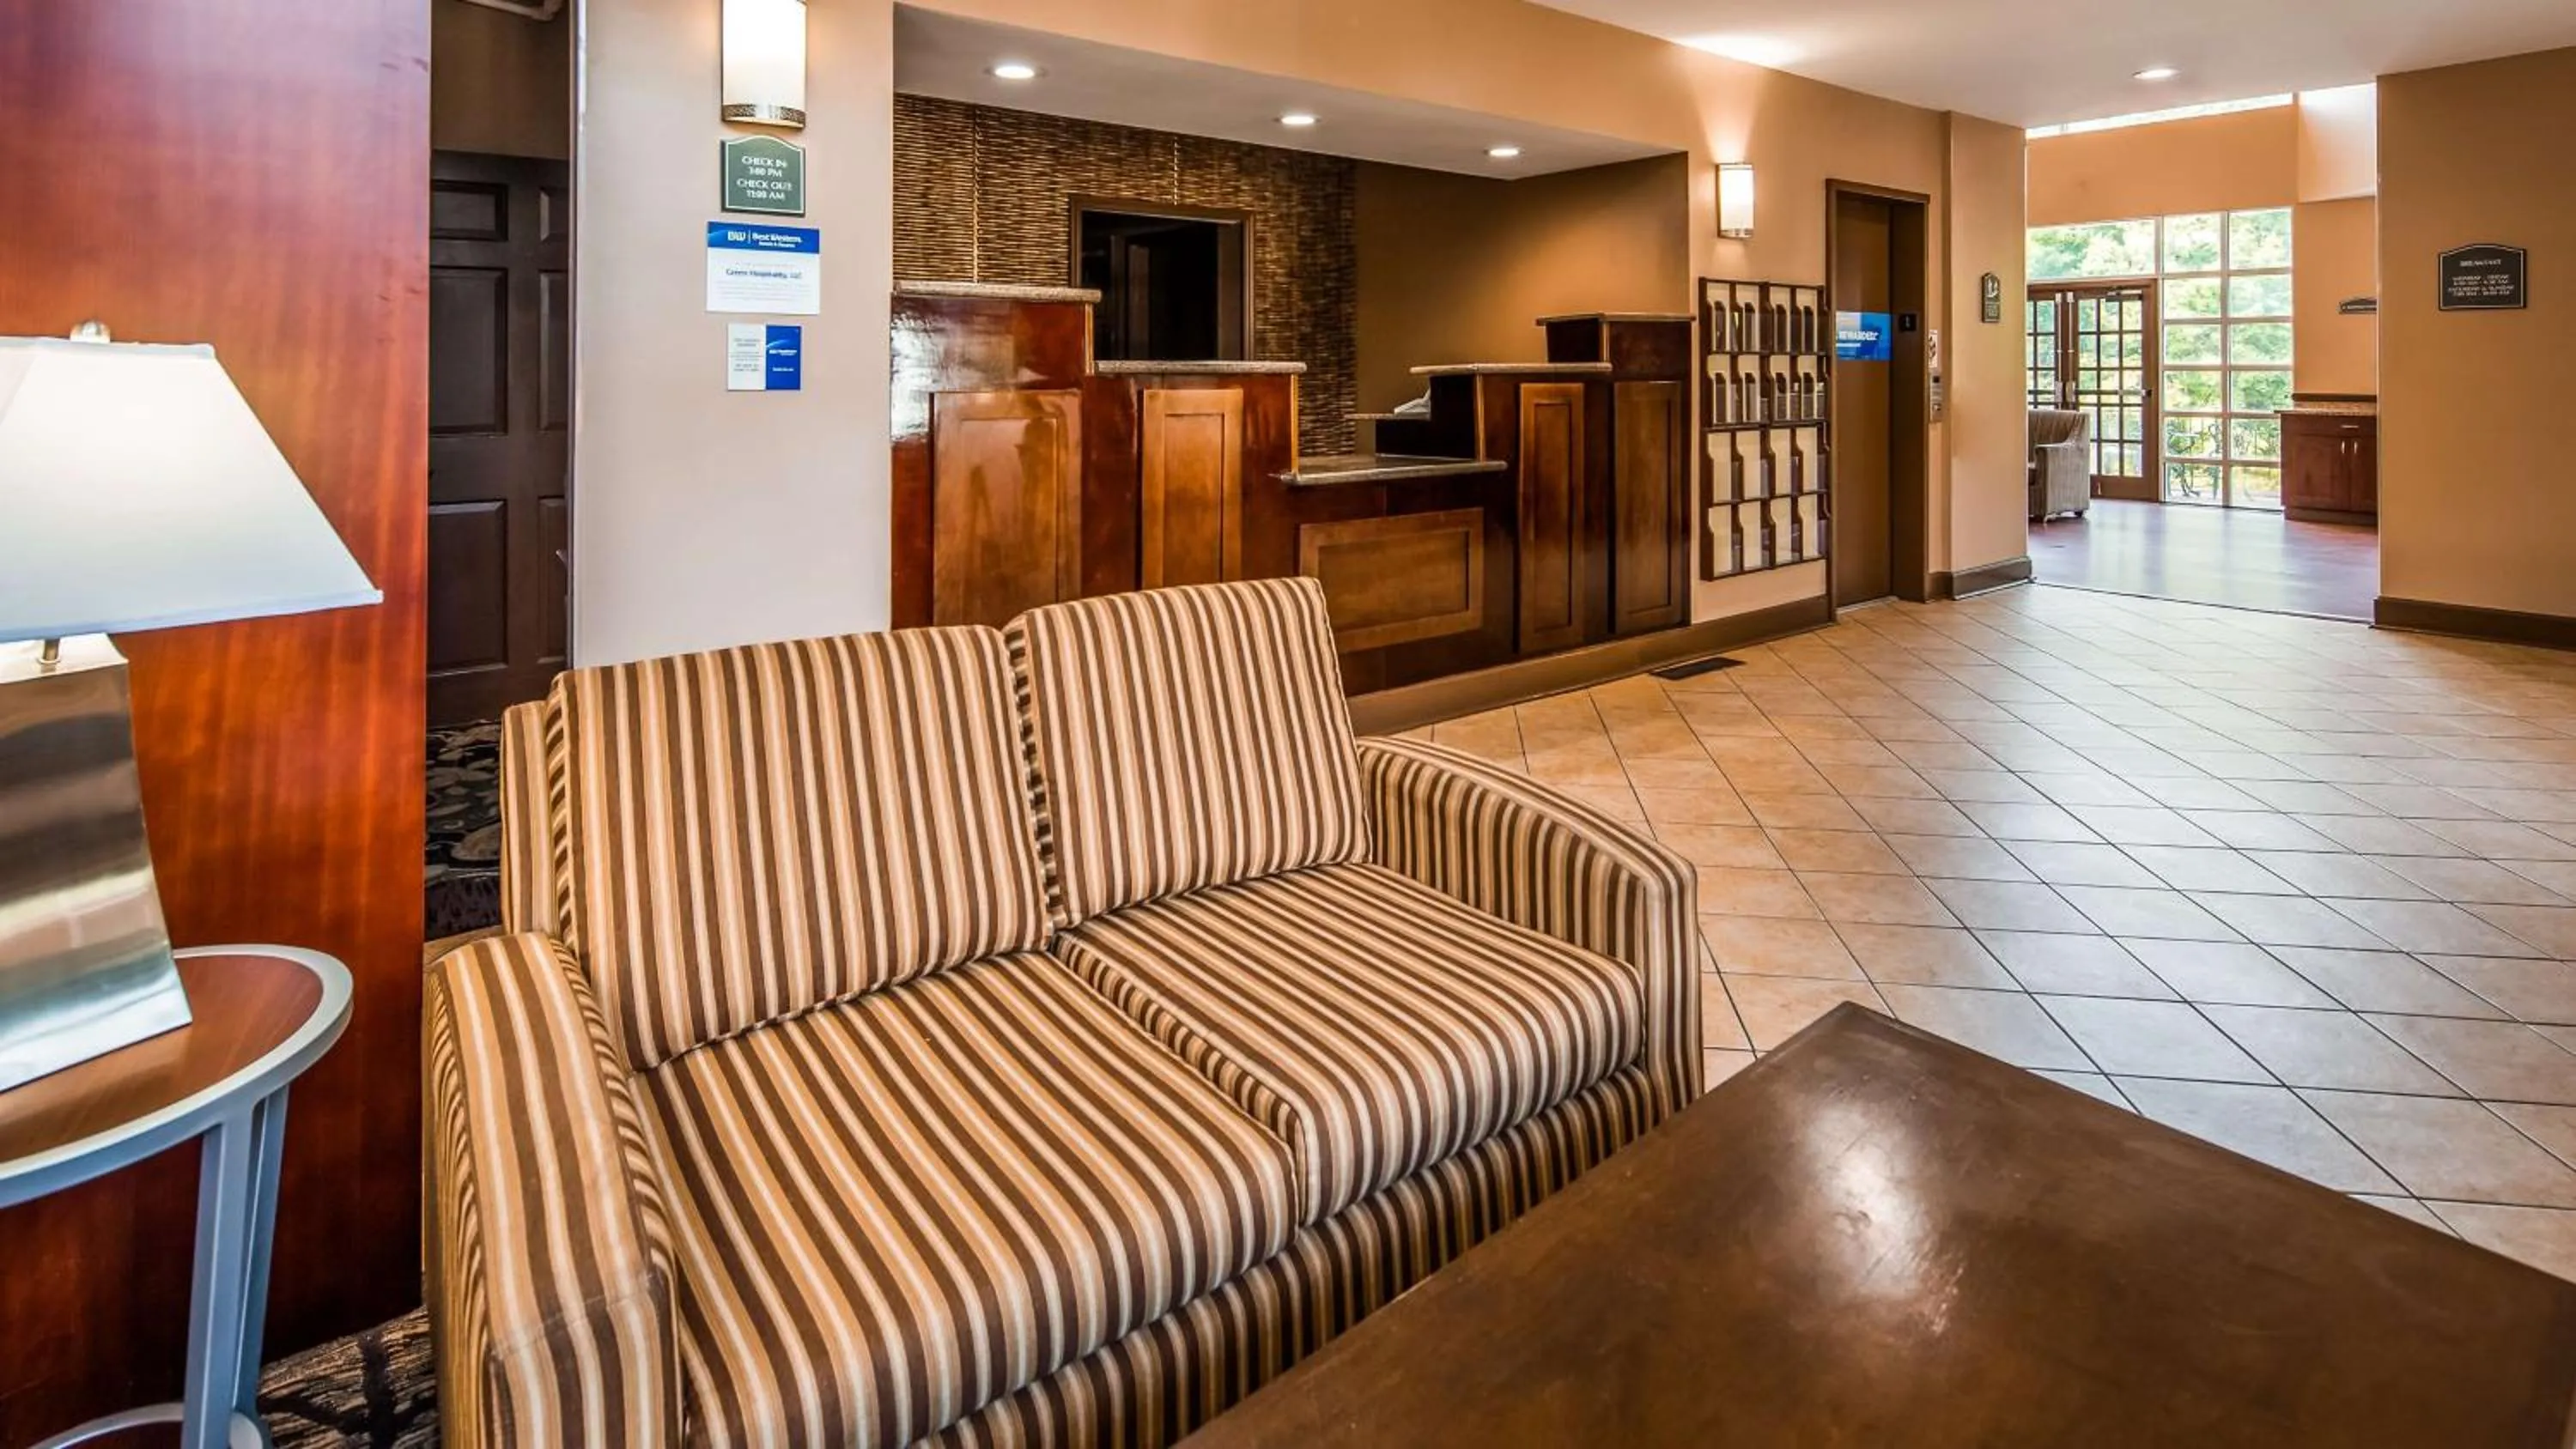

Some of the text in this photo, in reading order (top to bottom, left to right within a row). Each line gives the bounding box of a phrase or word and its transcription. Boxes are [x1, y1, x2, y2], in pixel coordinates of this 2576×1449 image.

[741, 155, 774, 167] CHECK
[767, 167, 783, 177] PM
[736, 178, 769, 189] CHECK
[769, 191, 786, 201] AM
